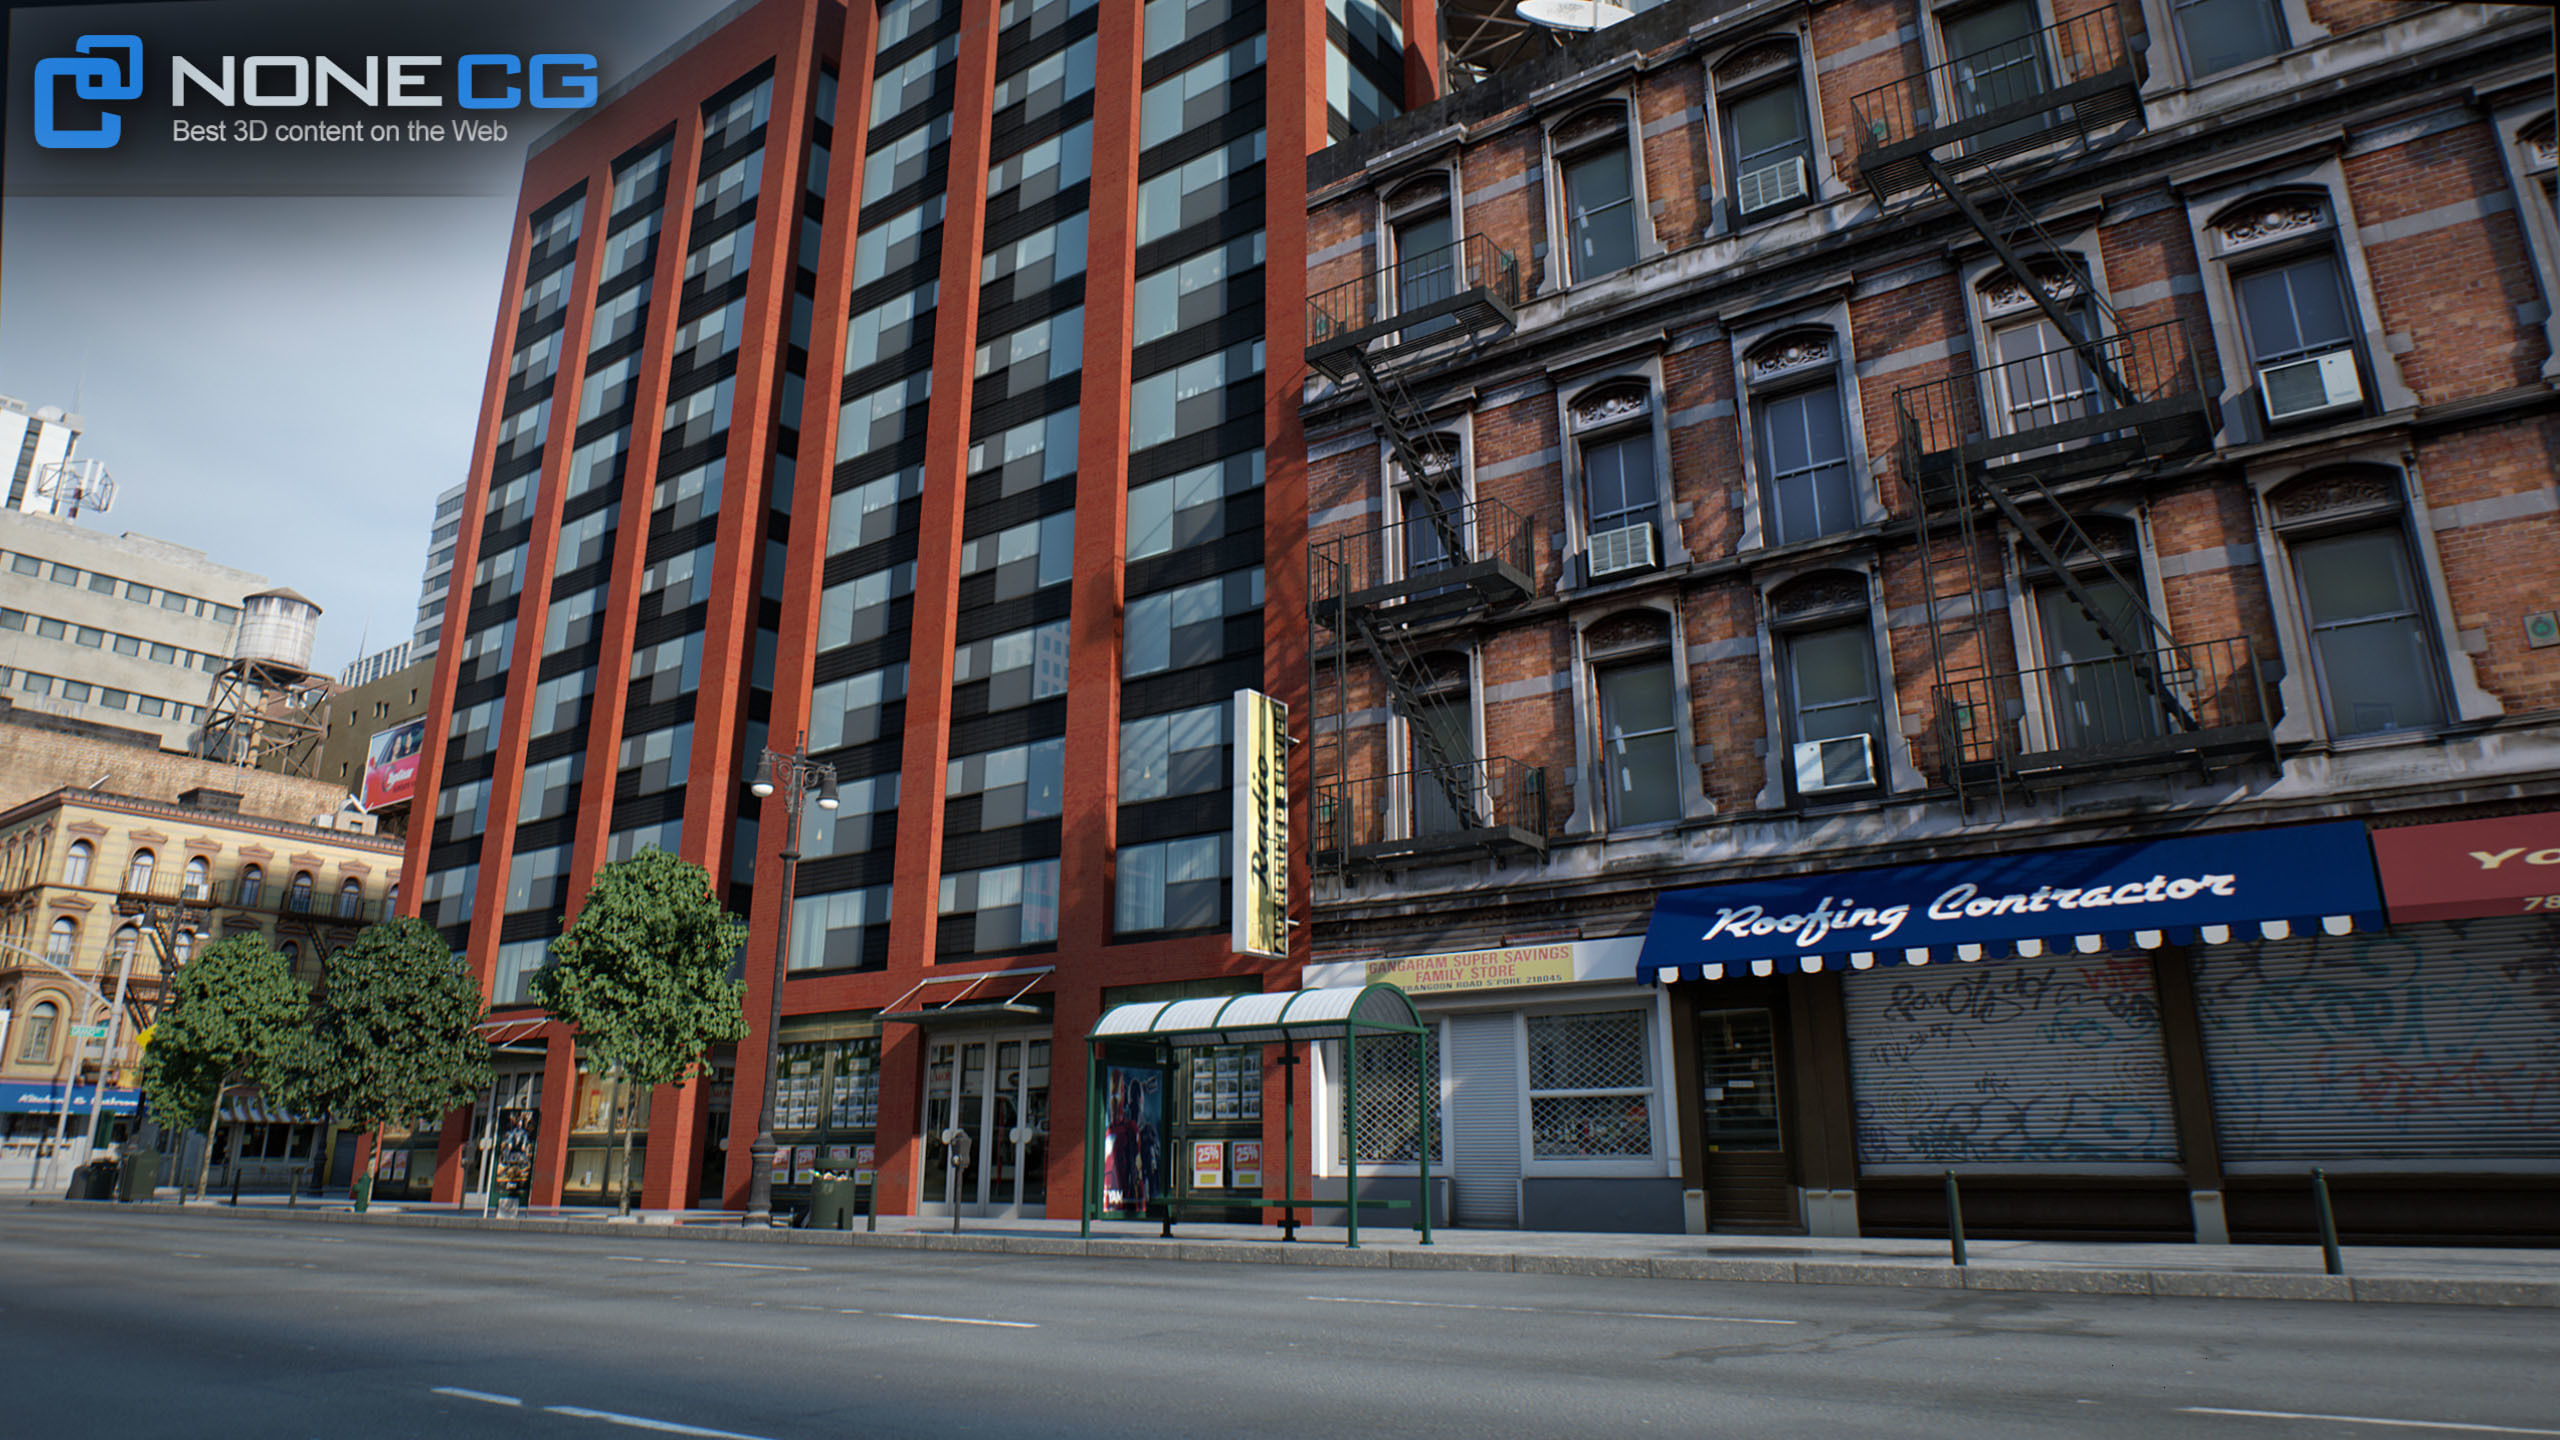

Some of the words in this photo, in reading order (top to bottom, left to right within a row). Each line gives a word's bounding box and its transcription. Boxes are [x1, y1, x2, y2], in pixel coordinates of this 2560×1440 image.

[1251, 755, 1269, 895] Radio
[1274, 808, 1286, 954] AUTHORIZED
[1702, 896, 1909, 947] Roofing
[1928, 875, 2236, 921] Contractor
[1368, 956, 1448, 975] GANGARAM
[1453, 950, 1498, 968] SUPER
[1504, 945, 1570, 963] SAVINGS
[1415, 968, 1464, 983] FAMILY
[1470, 963, 1516, 979] STORE
[1455, 979, 1483, 989] ROAD
